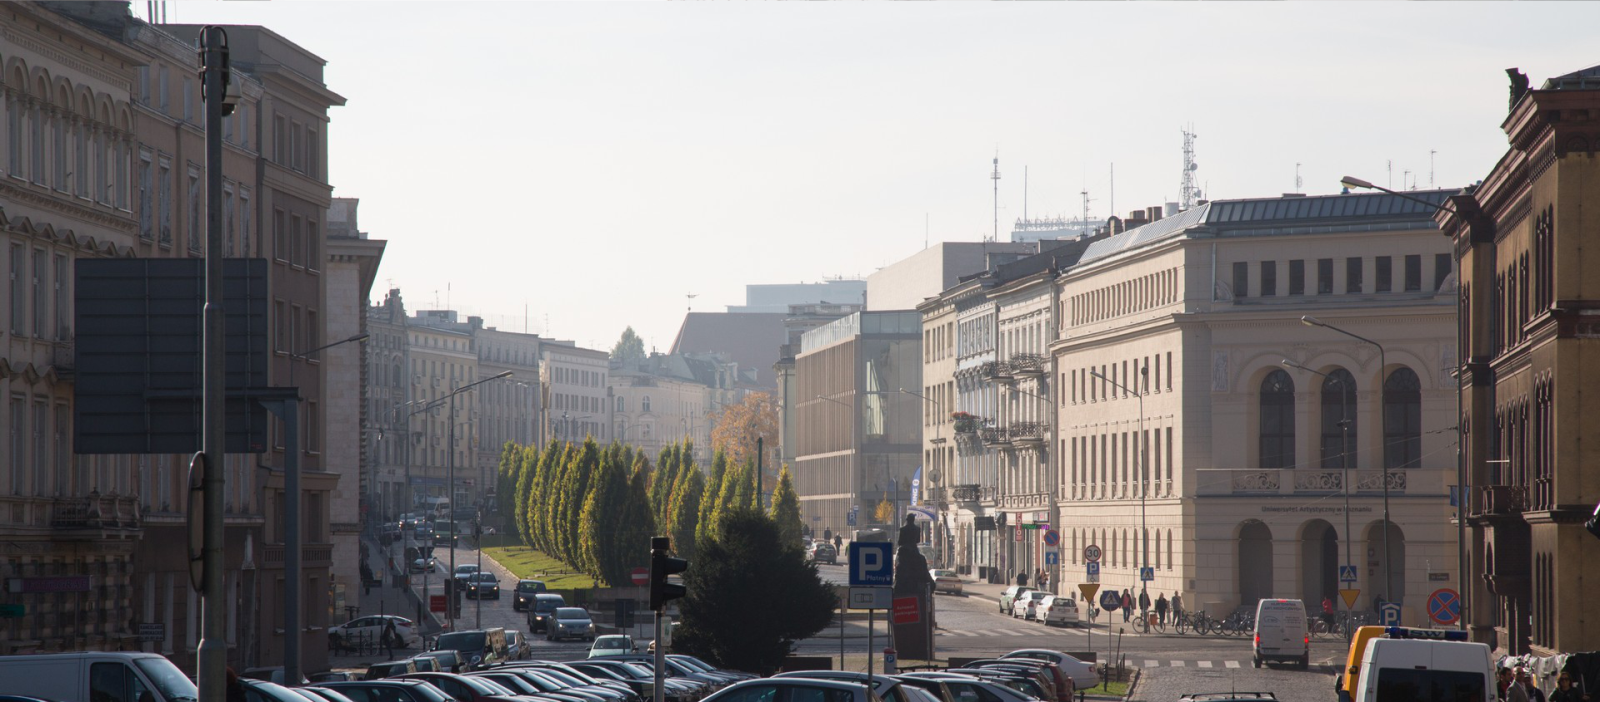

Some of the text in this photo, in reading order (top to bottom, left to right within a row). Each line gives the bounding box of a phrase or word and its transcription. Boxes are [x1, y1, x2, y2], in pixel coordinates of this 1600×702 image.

[1087, 549, 1099, 558] 30
[859, 547, 883, 581] P
[1090, 563, 1097, 573] P
[1384, 610, 1397, 626] P
